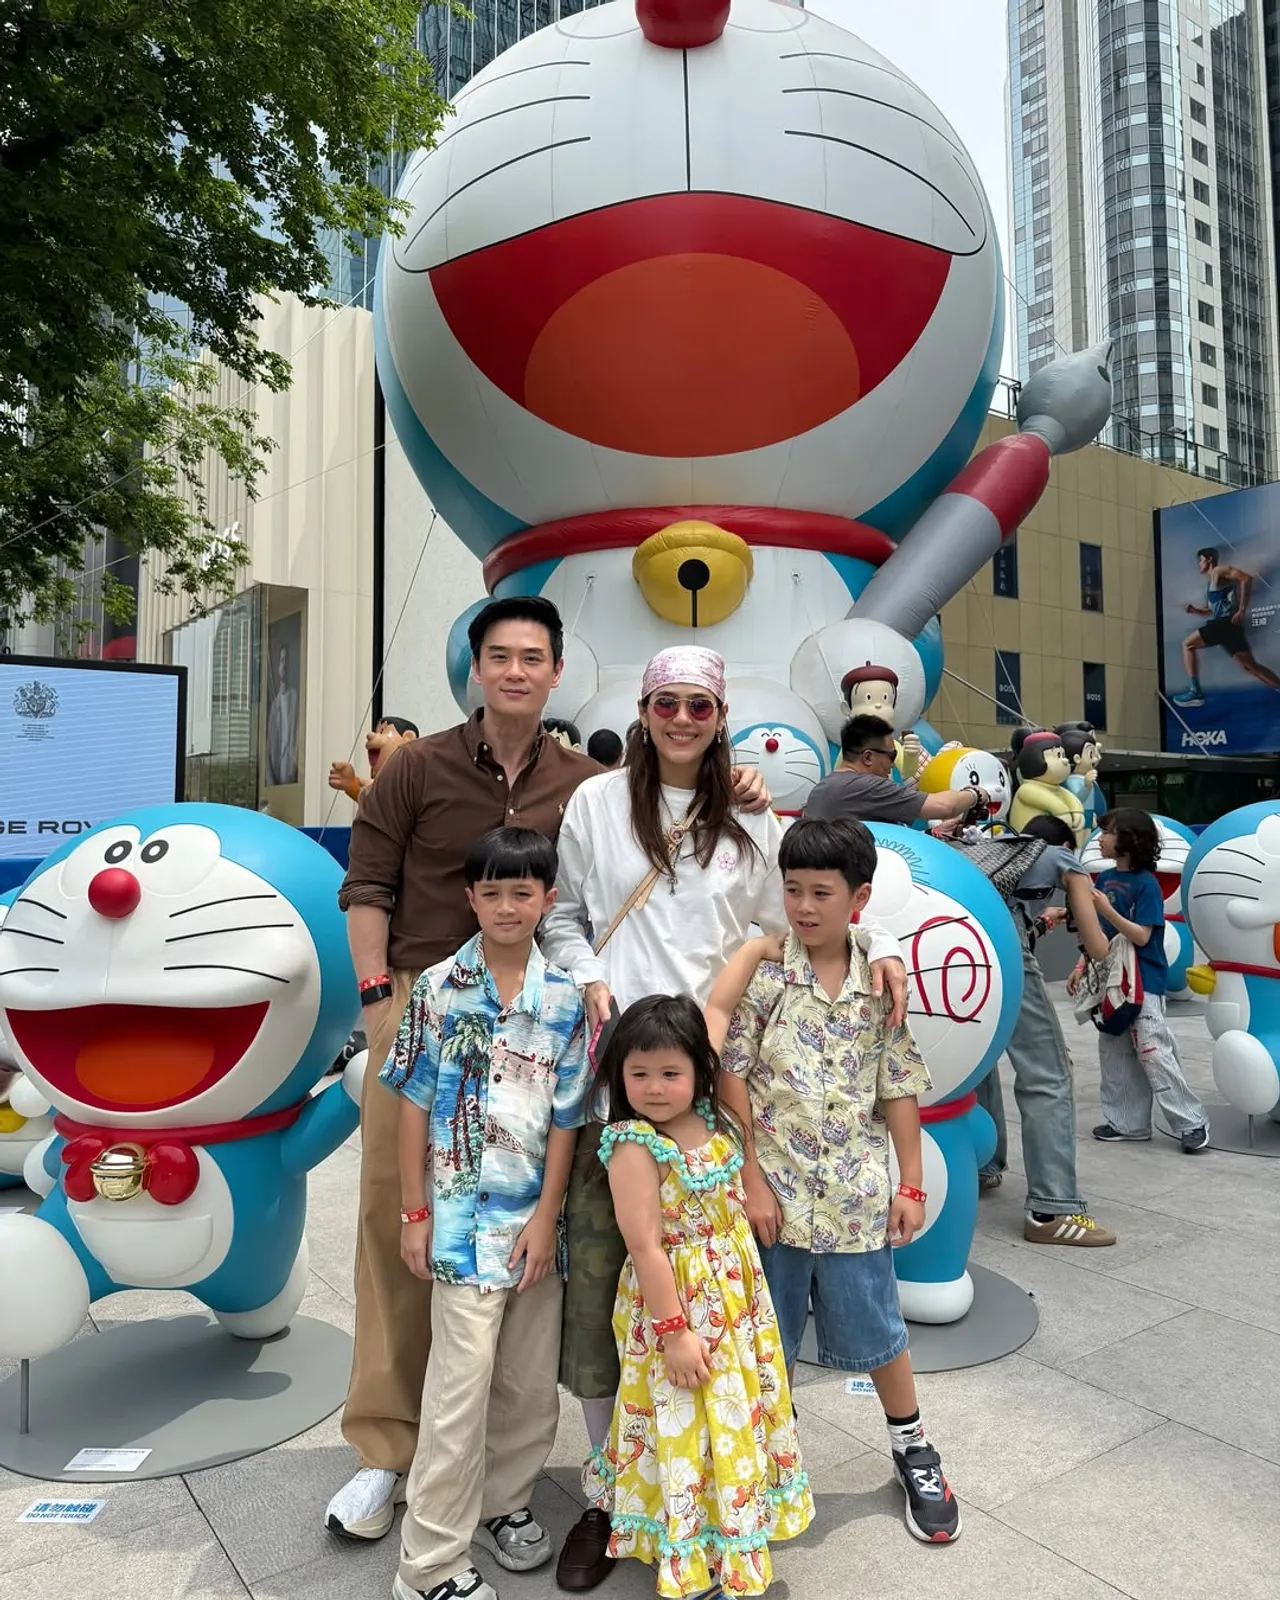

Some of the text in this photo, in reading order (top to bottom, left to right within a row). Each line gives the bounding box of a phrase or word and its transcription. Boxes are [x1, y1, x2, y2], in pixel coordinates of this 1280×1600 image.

[1182, 730, 1227, 747] HOKA
[33, 1503, 97, 1512] 请勿触碰
